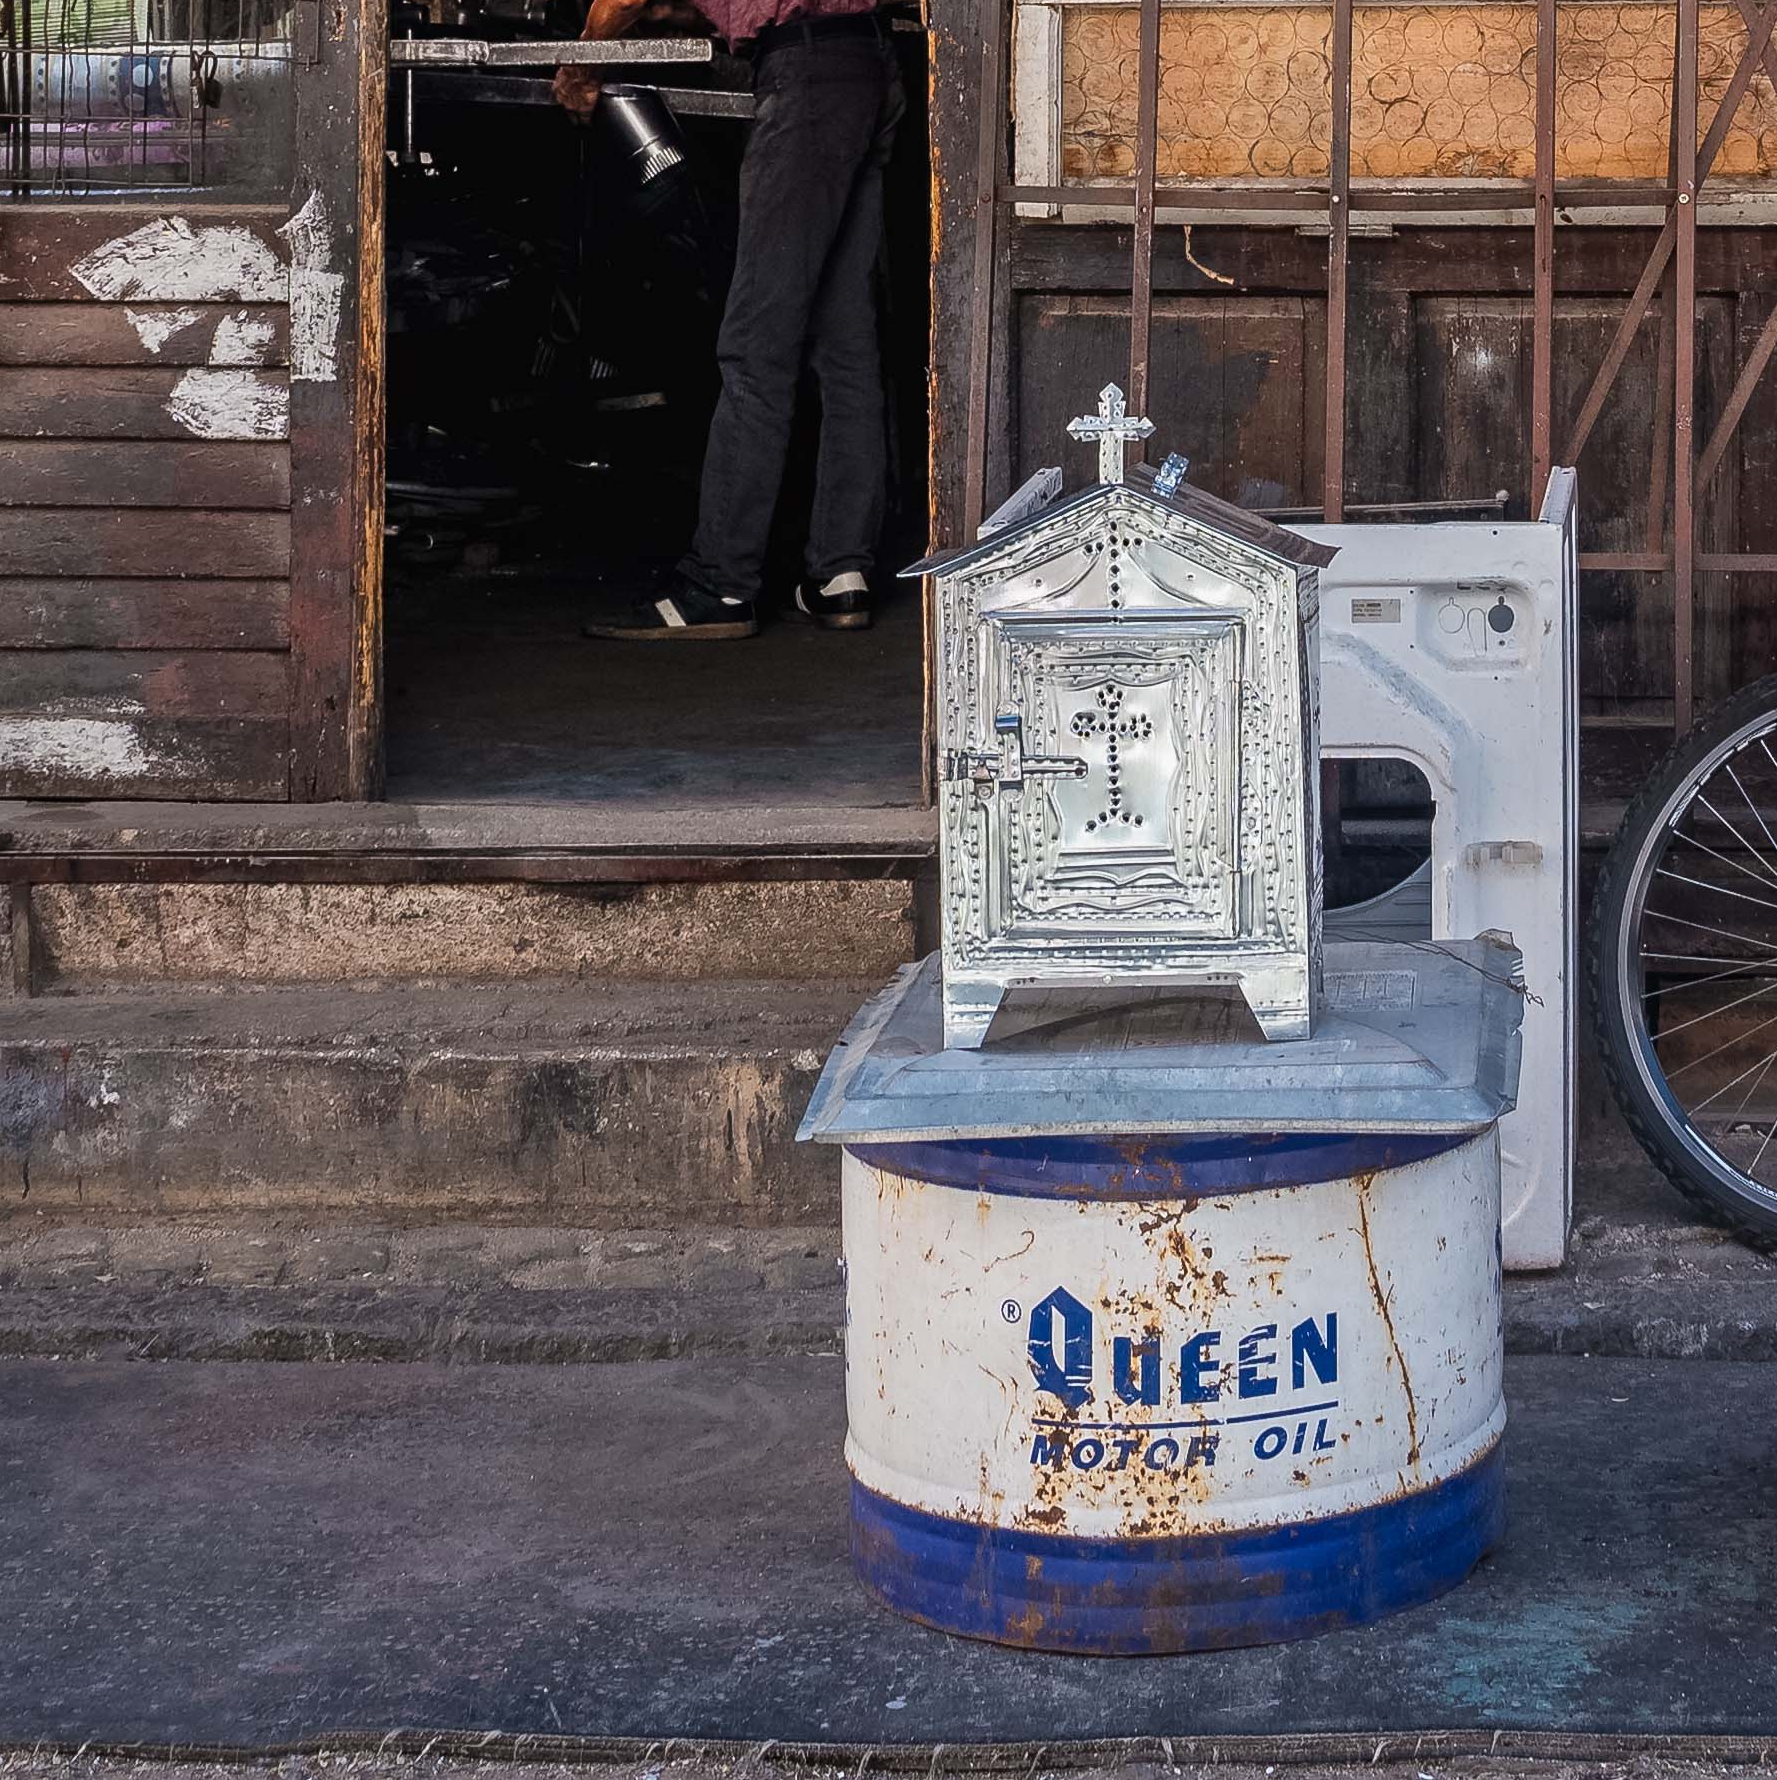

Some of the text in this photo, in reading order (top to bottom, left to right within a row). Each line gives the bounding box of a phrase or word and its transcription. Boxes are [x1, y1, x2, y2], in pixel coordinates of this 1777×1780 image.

[1027, 1285, 1339, 1410] QUEEN
[1029, 1418, 1337, 1471] MOTOR OIL
